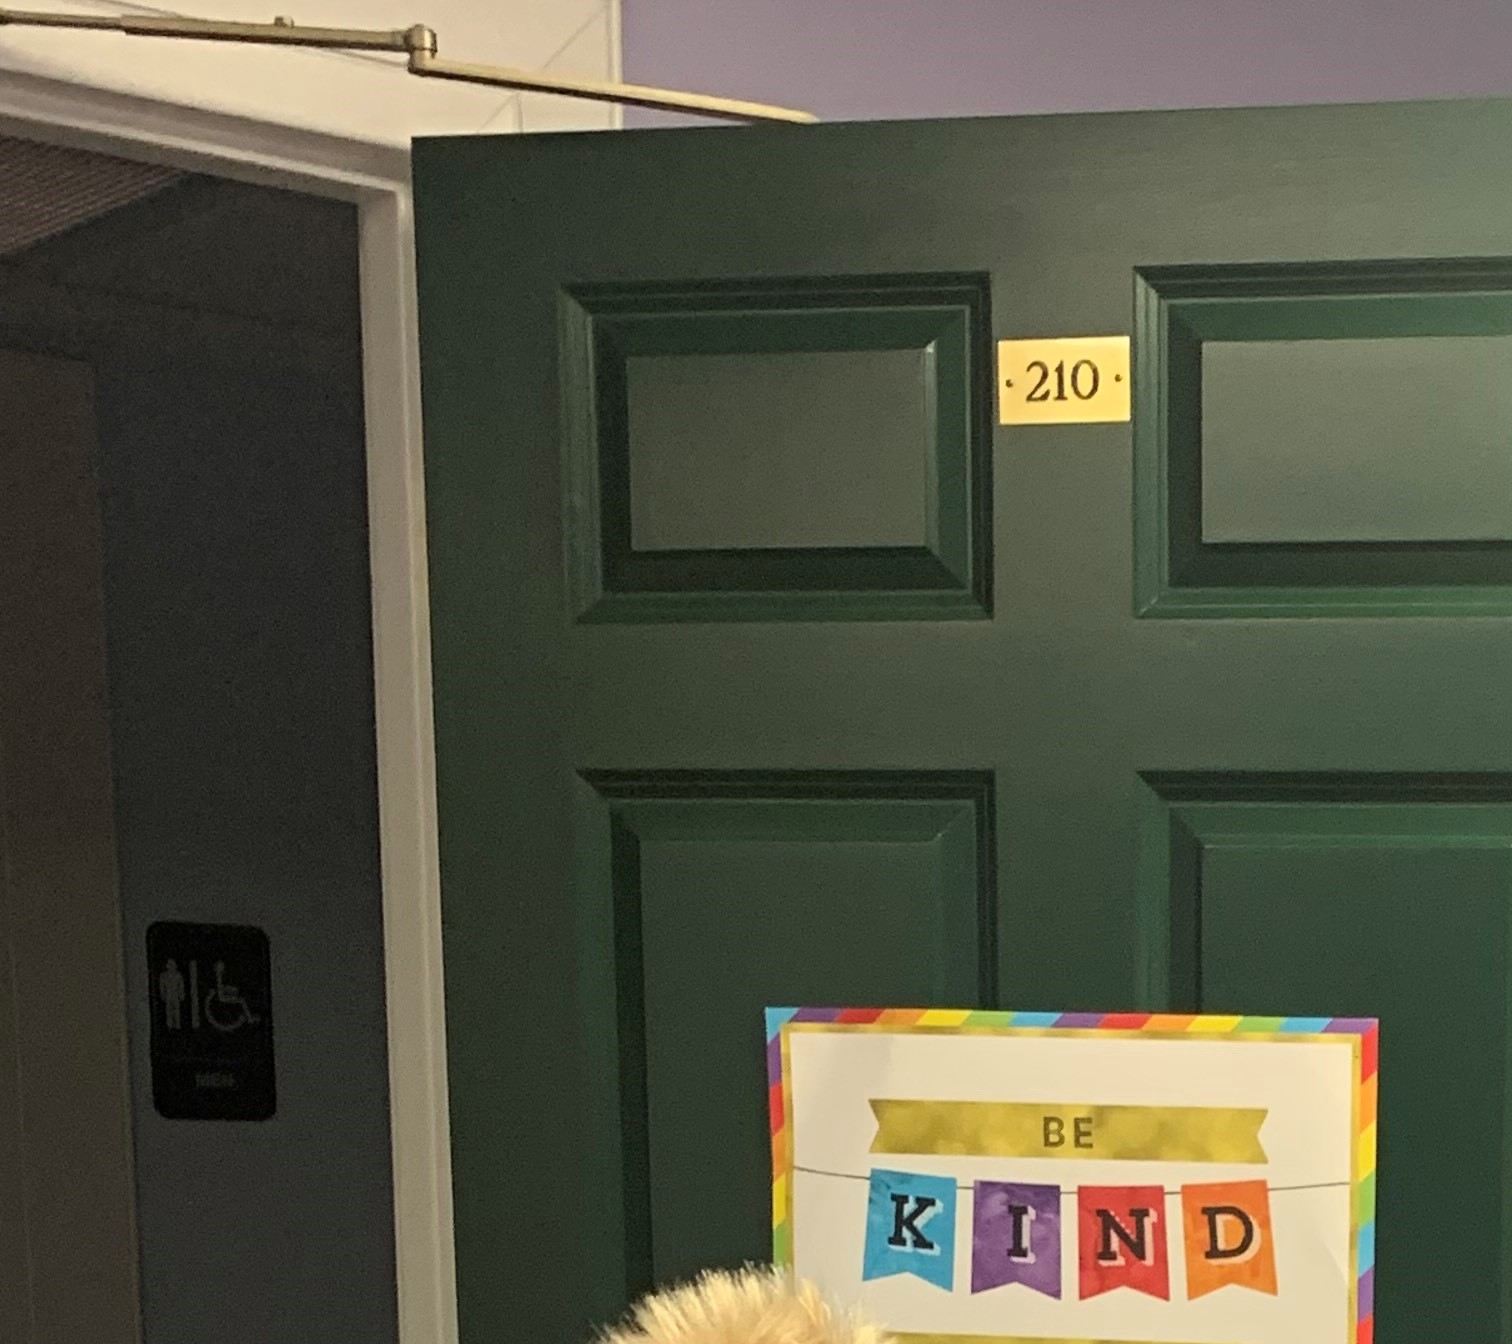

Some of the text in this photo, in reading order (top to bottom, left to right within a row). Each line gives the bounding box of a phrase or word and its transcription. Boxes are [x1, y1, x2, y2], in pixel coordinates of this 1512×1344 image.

[1026, 359, 1099, 403] 210
[1043, 1116, 1095, 1149] BE
[887, 1193, 1258, 1266] KIND
